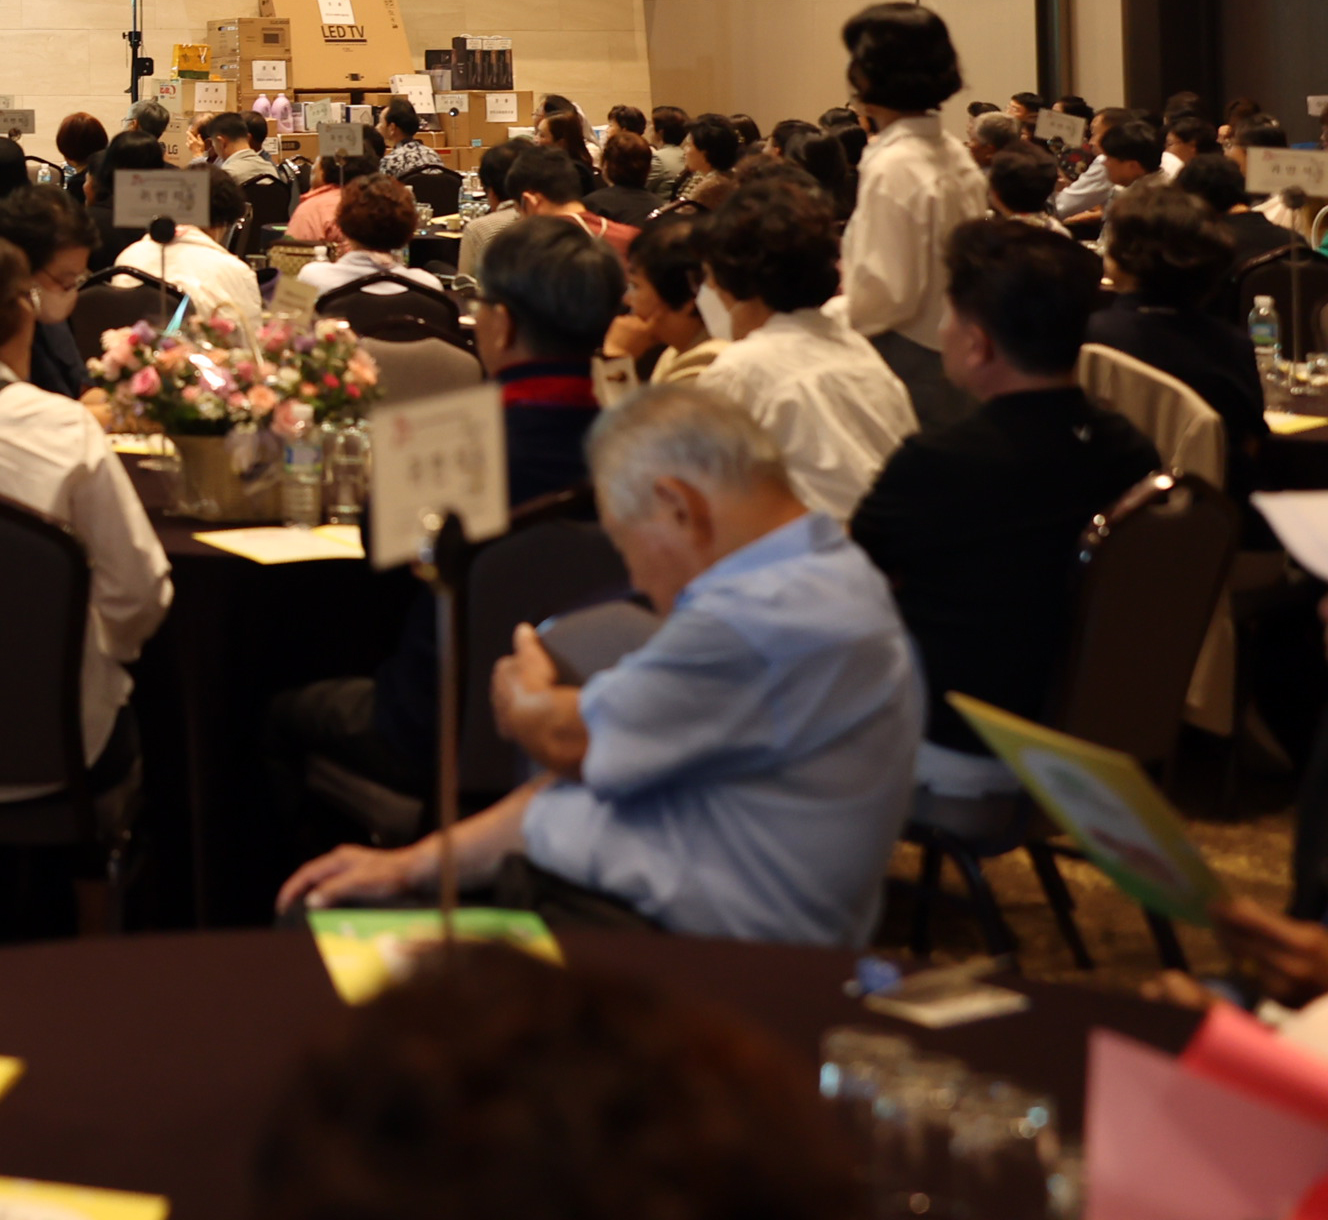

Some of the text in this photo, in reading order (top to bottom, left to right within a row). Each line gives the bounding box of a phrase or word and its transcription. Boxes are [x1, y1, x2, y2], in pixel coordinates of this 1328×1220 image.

[320, 24, 365, 39] LED TV
[167, 143, 179, 156] LG
